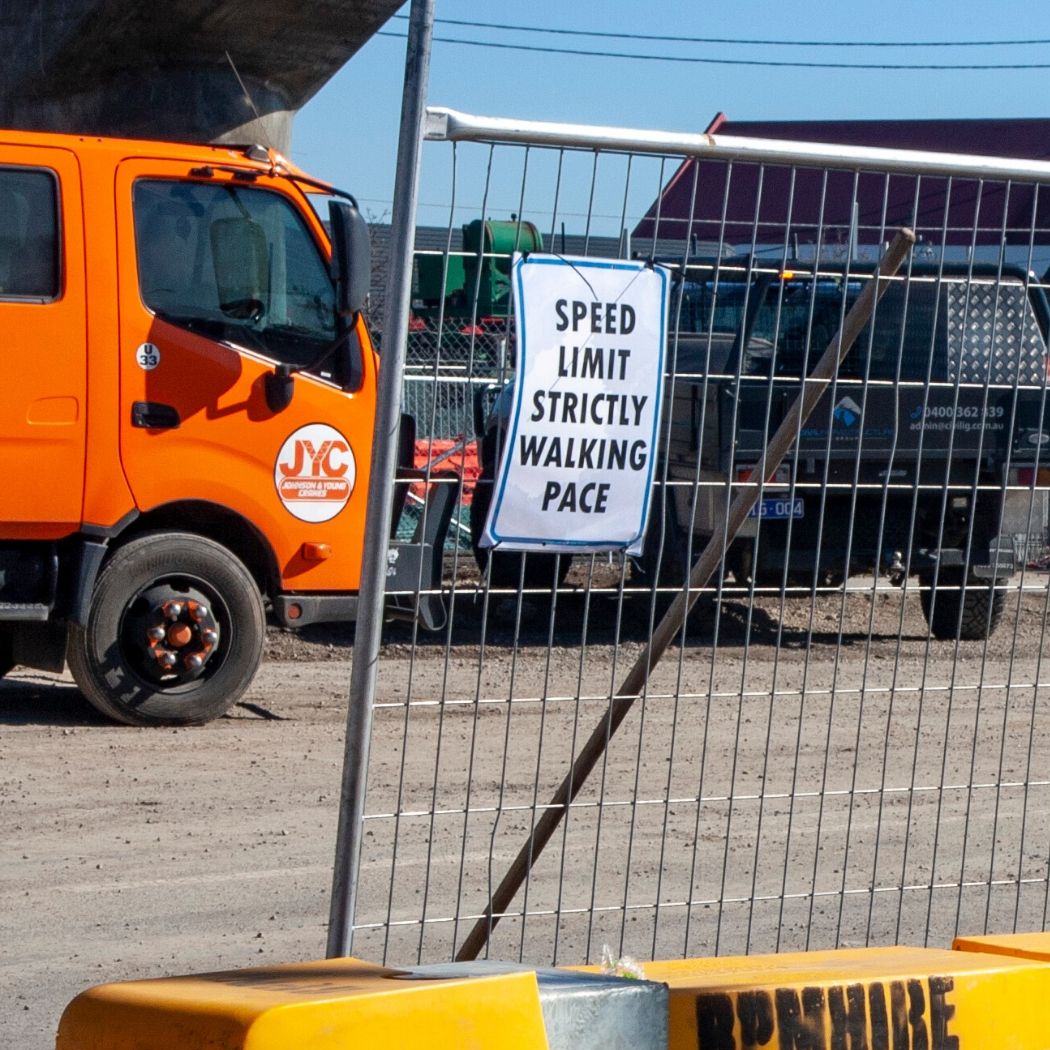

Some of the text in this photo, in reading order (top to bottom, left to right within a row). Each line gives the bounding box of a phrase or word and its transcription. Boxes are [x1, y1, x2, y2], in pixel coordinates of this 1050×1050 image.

[555, 299, 636, 335] SPEED
[140, 355, 158, 366] 33
[144, 345, 153, 355] U
[558, 346, 631, 381] LIMIT
[531, 390, 648, 426] STRICTLY
[956, 406, 978, 418] 362
[279, 440, 349, 478] JYC
[520, 435, 647, 471] WALKING
[541, 481, 611, 514] PACE
